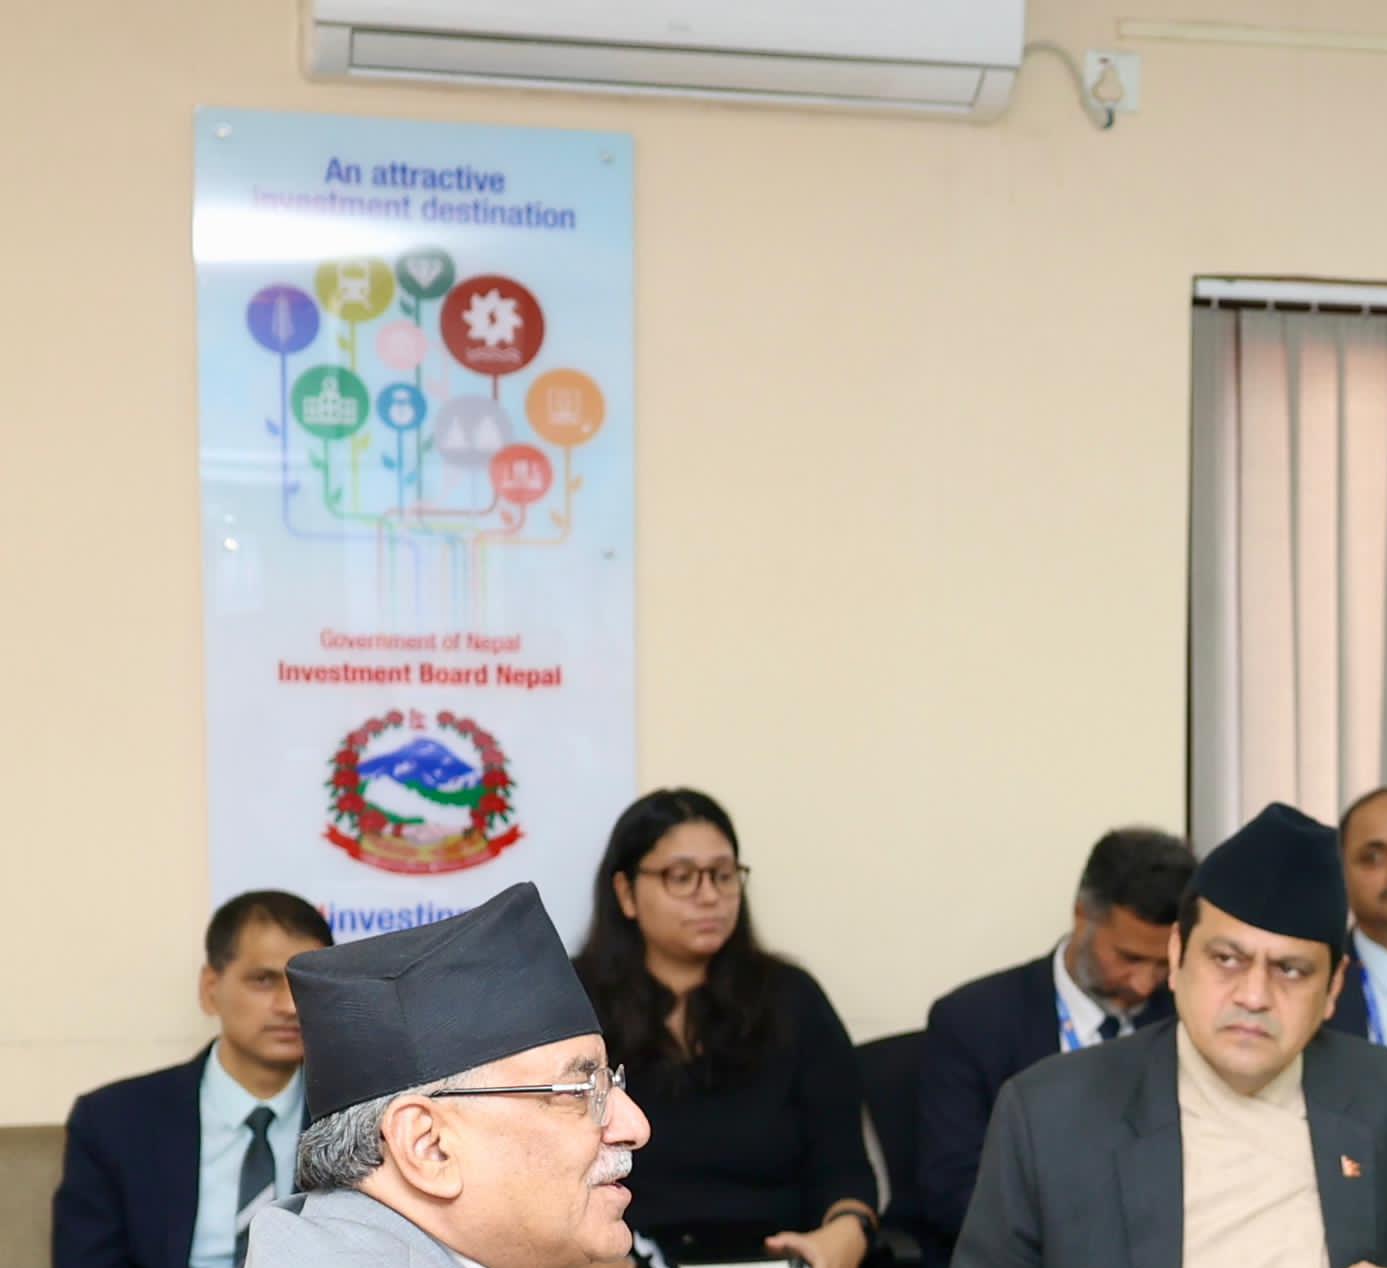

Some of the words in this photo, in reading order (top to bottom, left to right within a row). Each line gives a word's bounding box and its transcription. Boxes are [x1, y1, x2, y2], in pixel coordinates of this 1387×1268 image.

[325, 157, 362, 185] An
[372, 161, 507, 194] attractive
[254, 186, 411, 222] investment
[423, 198, 577, 230] destination
[320, 629, 437, 651] Government
[442, 631, 461, 651] of
[467, 633, 522, 655] Nepal
[278, 661, 412, 685] Investment
[419, 662, 489, 687] Board
[496, 665, 562, 690] Nepal
